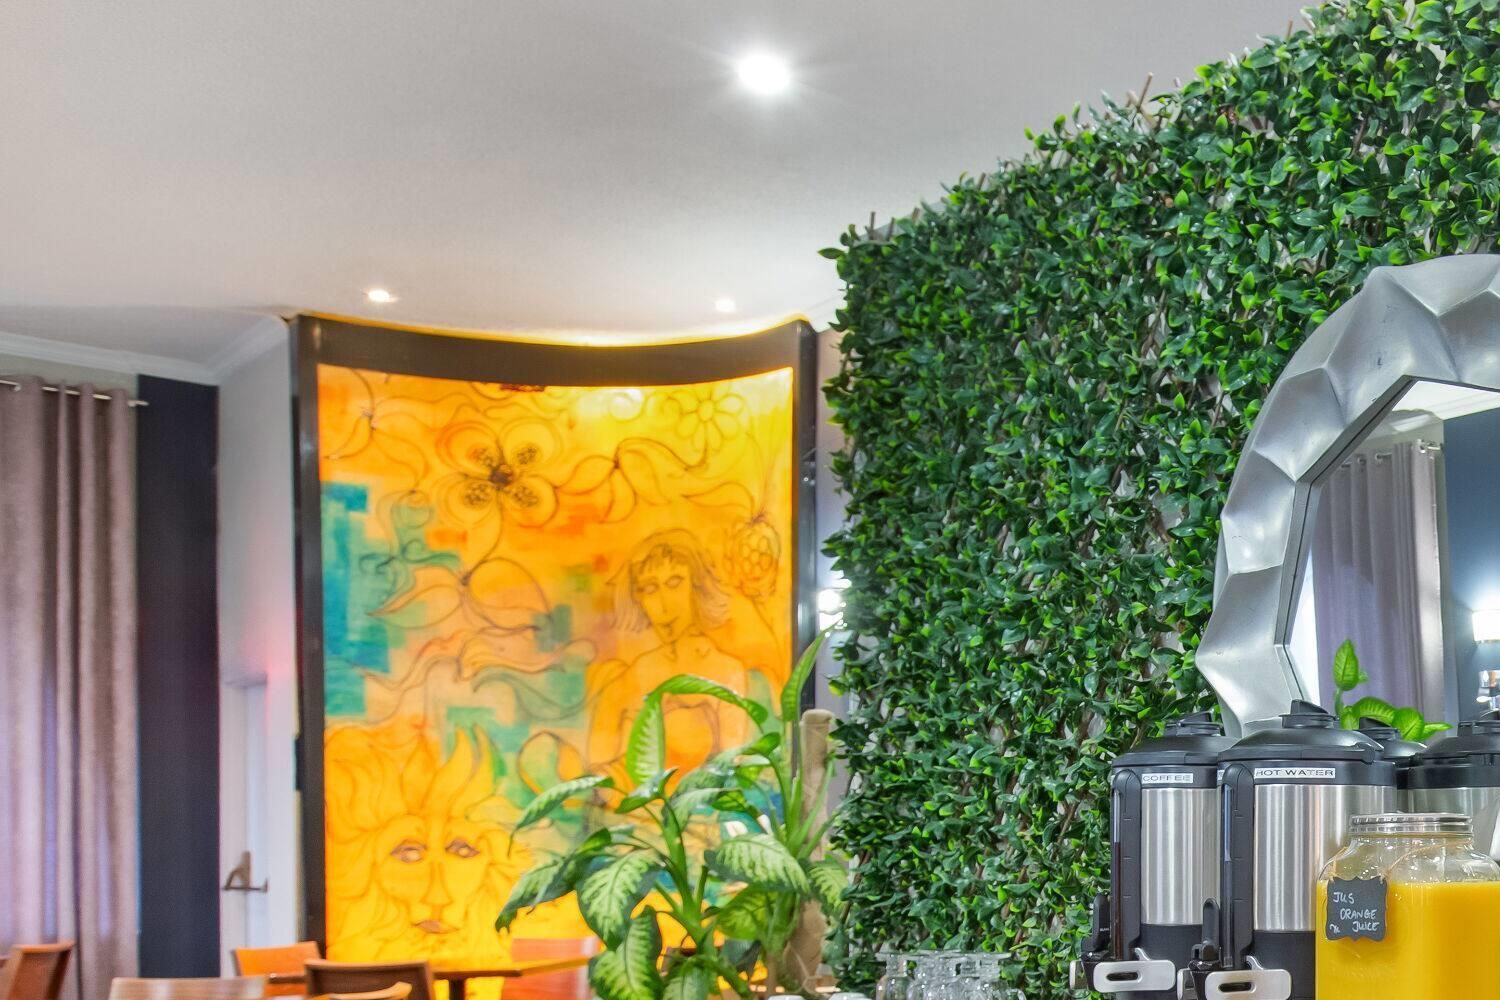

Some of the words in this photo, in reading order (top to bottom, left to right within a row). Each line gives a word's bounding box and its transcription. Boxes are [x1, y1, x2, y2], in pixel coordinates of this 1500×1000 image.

[1142, 774, 1192, 783] COFFEE
[1255, 769, 1280, 777] HOT
[1332, 891, 1355, 905] JUS
[1339, 907, 1378, 921] ORANGE
[1351, 921, 1380, 933] JUICE
